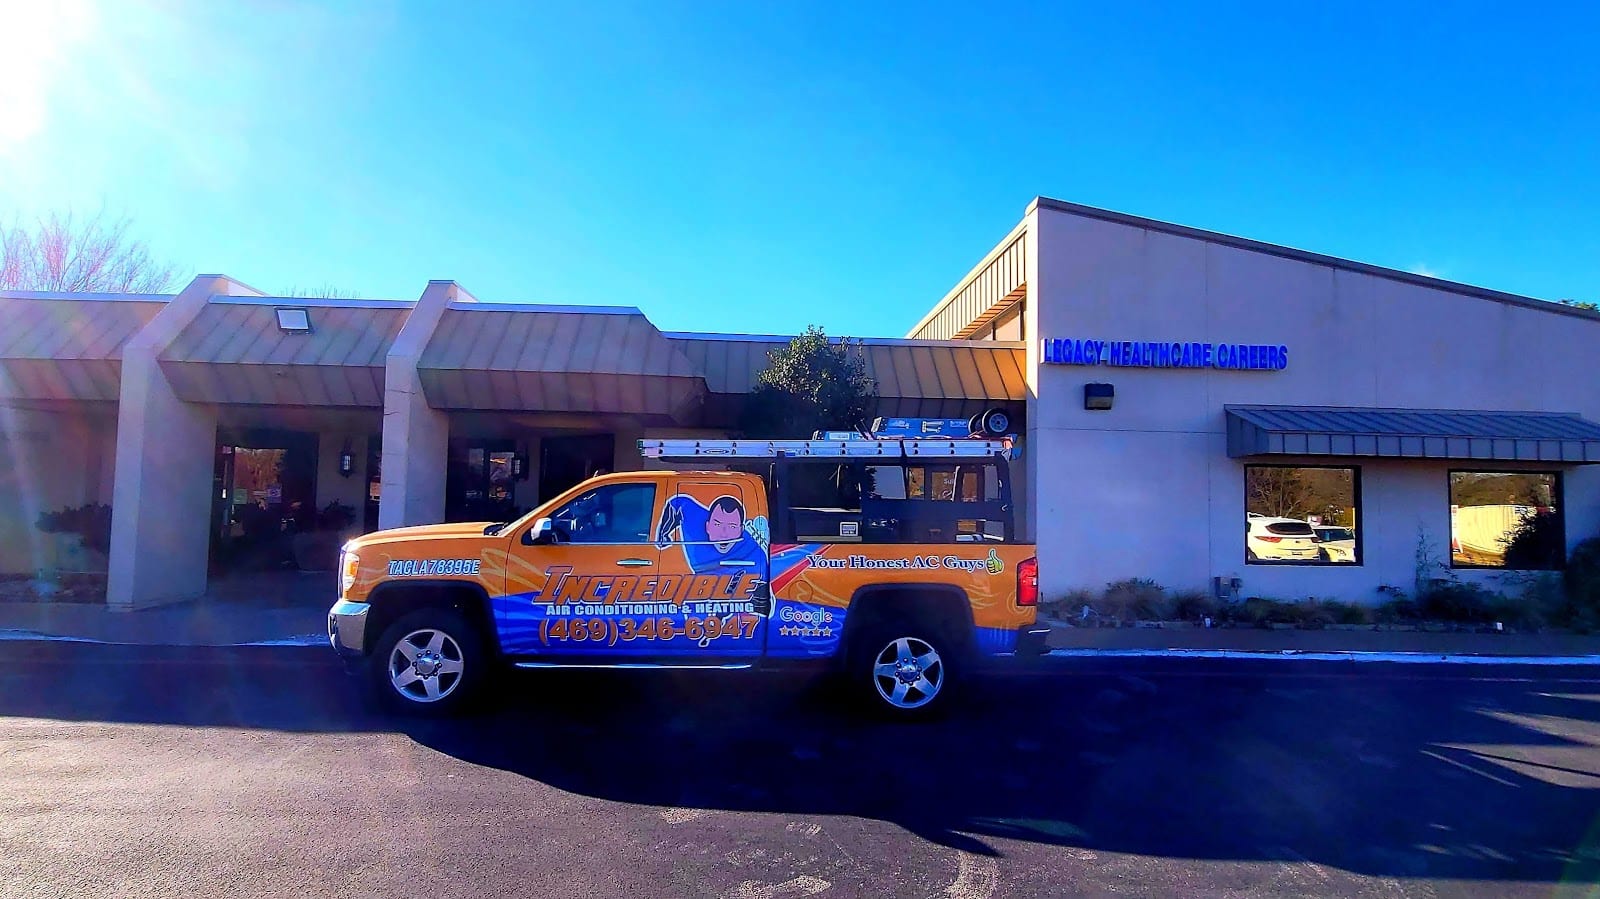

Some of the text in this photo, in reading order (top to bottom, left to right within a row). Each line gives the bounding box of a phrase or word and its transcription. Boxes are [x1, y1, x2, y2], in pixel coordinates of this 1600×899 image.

[1041, 338, 1288, 371] LEGACY HEALTHCARE CAREERS
[388, 559, 481, 576] TACLA78395E
[807, 555, 984, 573] Your Honest AC Guys
[534, 565, 762, 606] INCREDIBLE
[546, 602, 755, 616] AIR CONDITIONING & HEATING
[779, 606, 833, 625] Google
[538, 616, 760, 647] (469)346-6947
